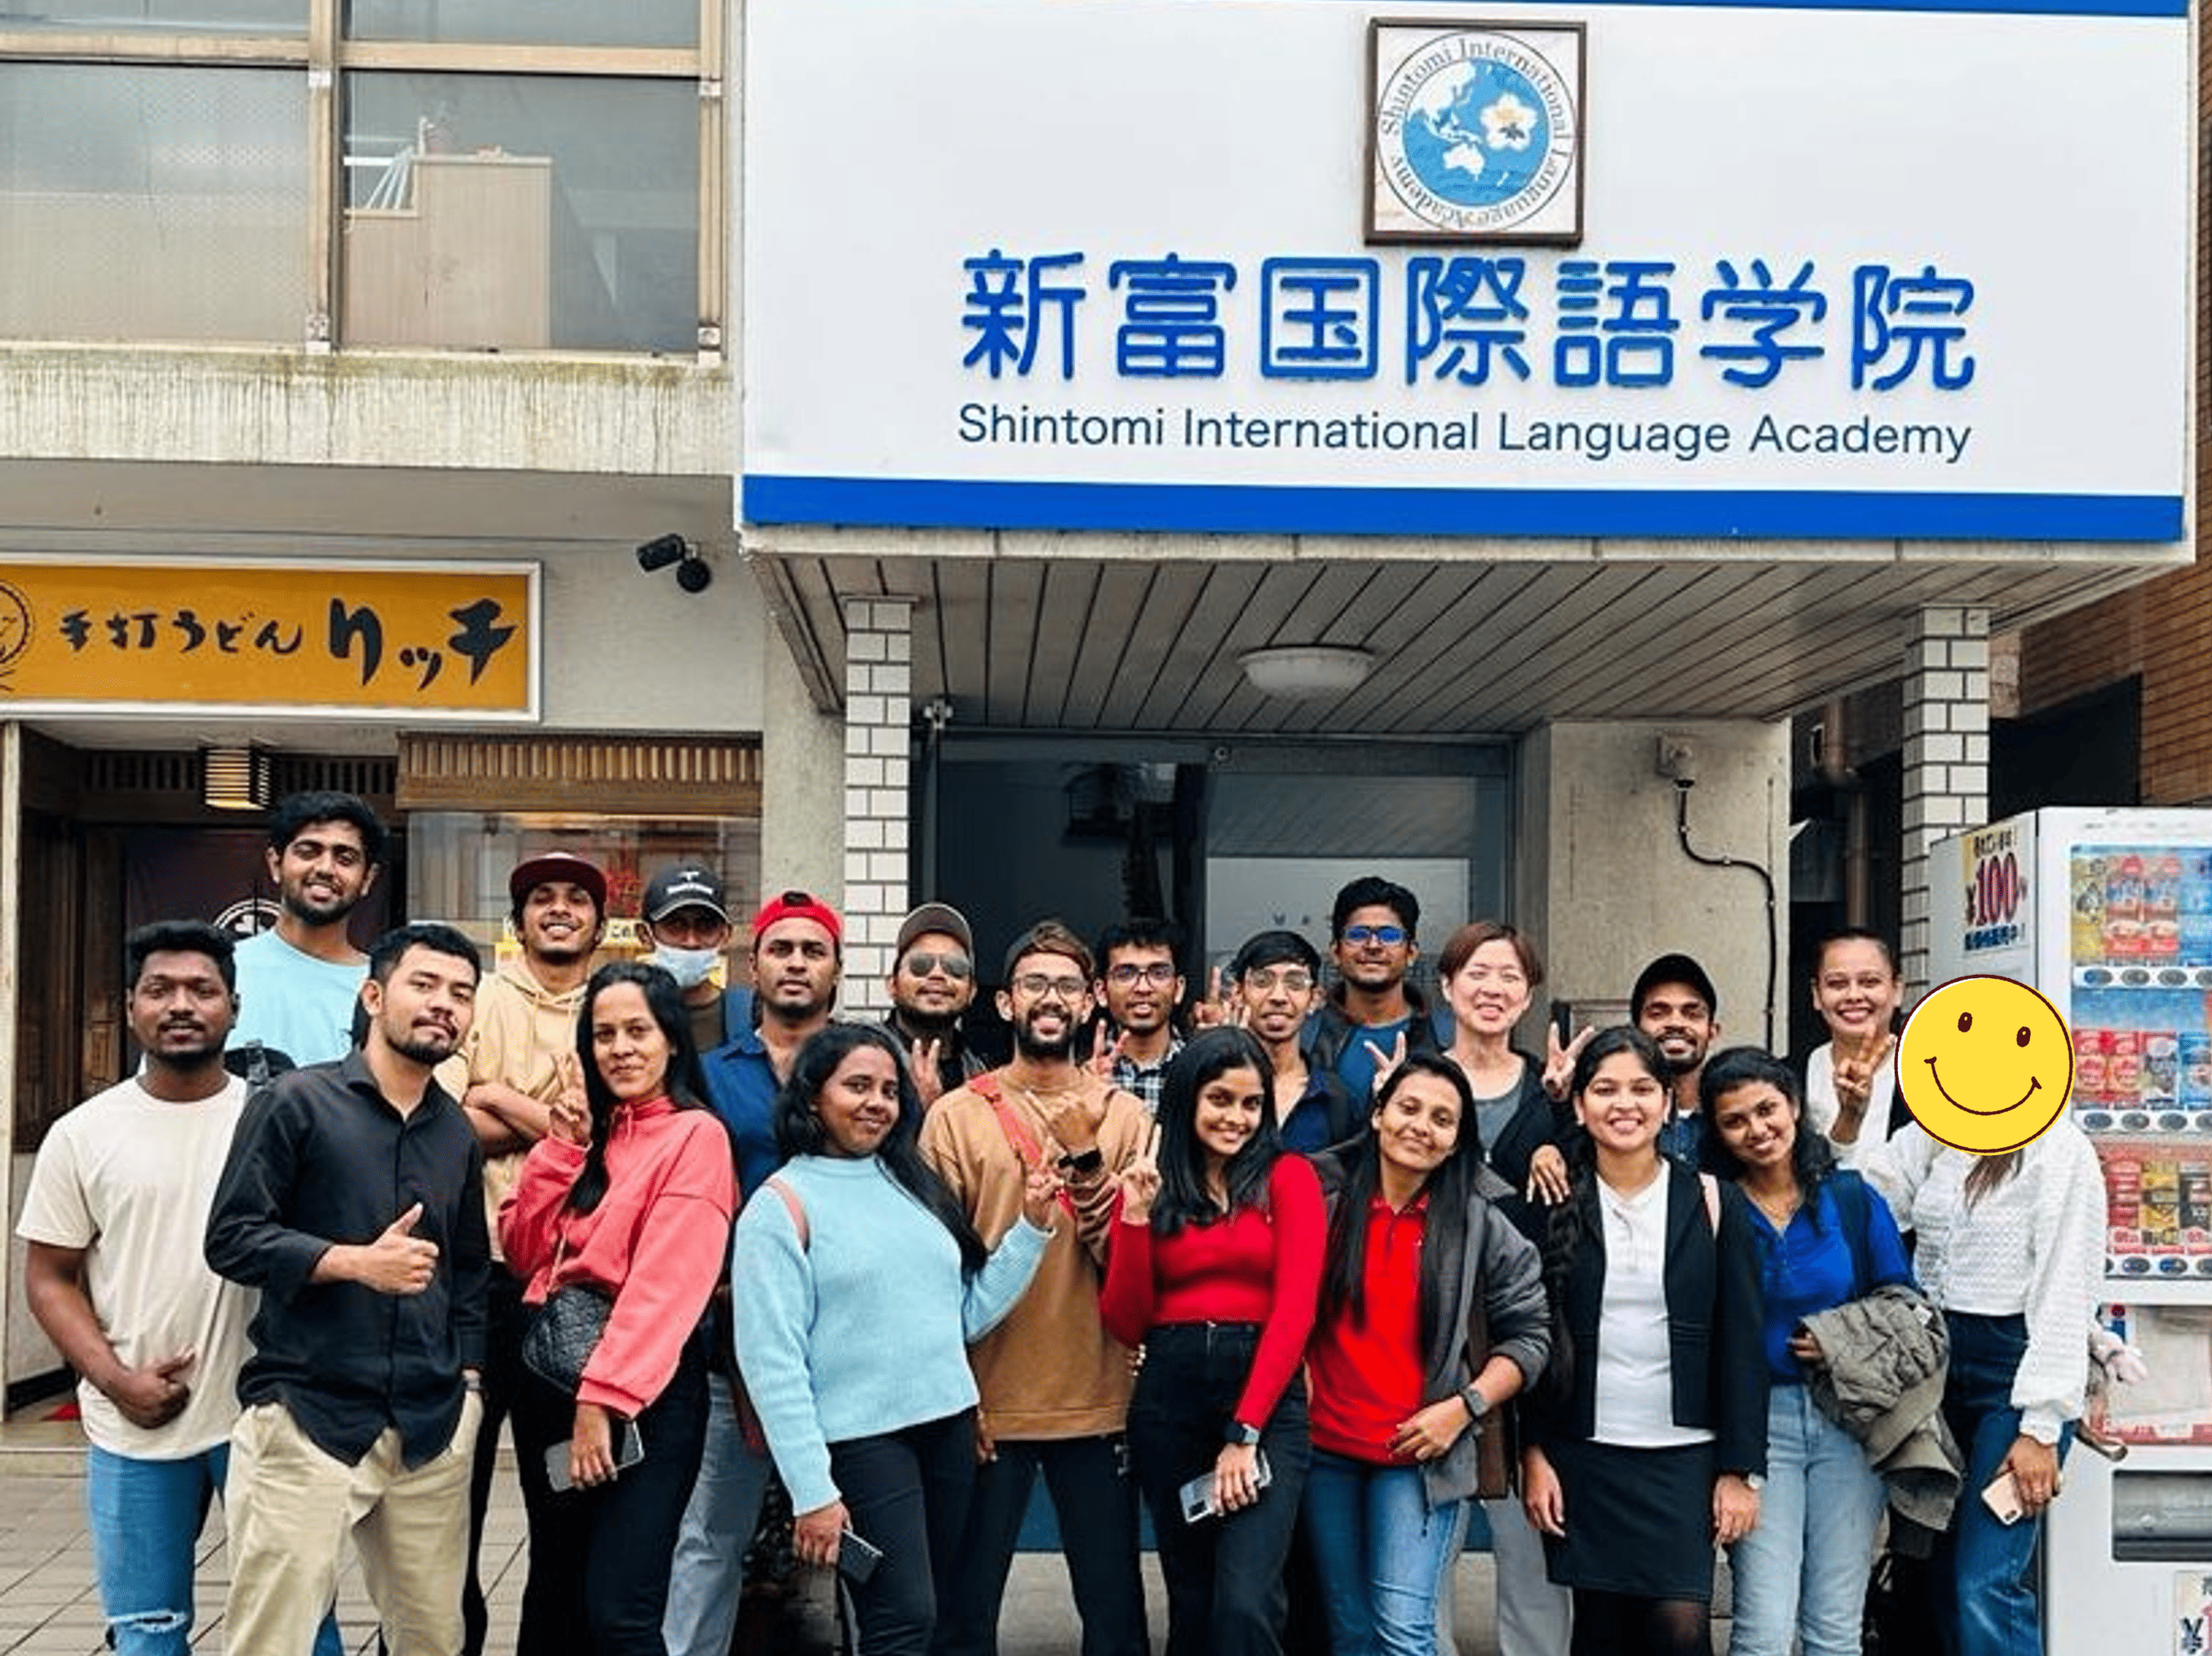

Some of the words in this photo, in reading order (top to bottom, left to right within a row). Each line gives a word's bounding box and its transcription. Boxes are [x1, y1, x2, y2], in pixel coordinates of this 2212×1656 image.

[1381, 43, 1453, 135] Shintomi
[1458, 38, 1571, 139] International
[1391, 157, 1466, 228] Academy
[1467, 148, 1570, 224] Language
[962, 248, 1975, 392] 新富国際語学院
[958, 403, 1164, 445] Shintomi
[1184, 409, 1479, 450] International
[1499, 413, 1731, 462] Language
[1749, 414, 1972, 463] Academy
[60, 610, 303, 654] 手打うどん
